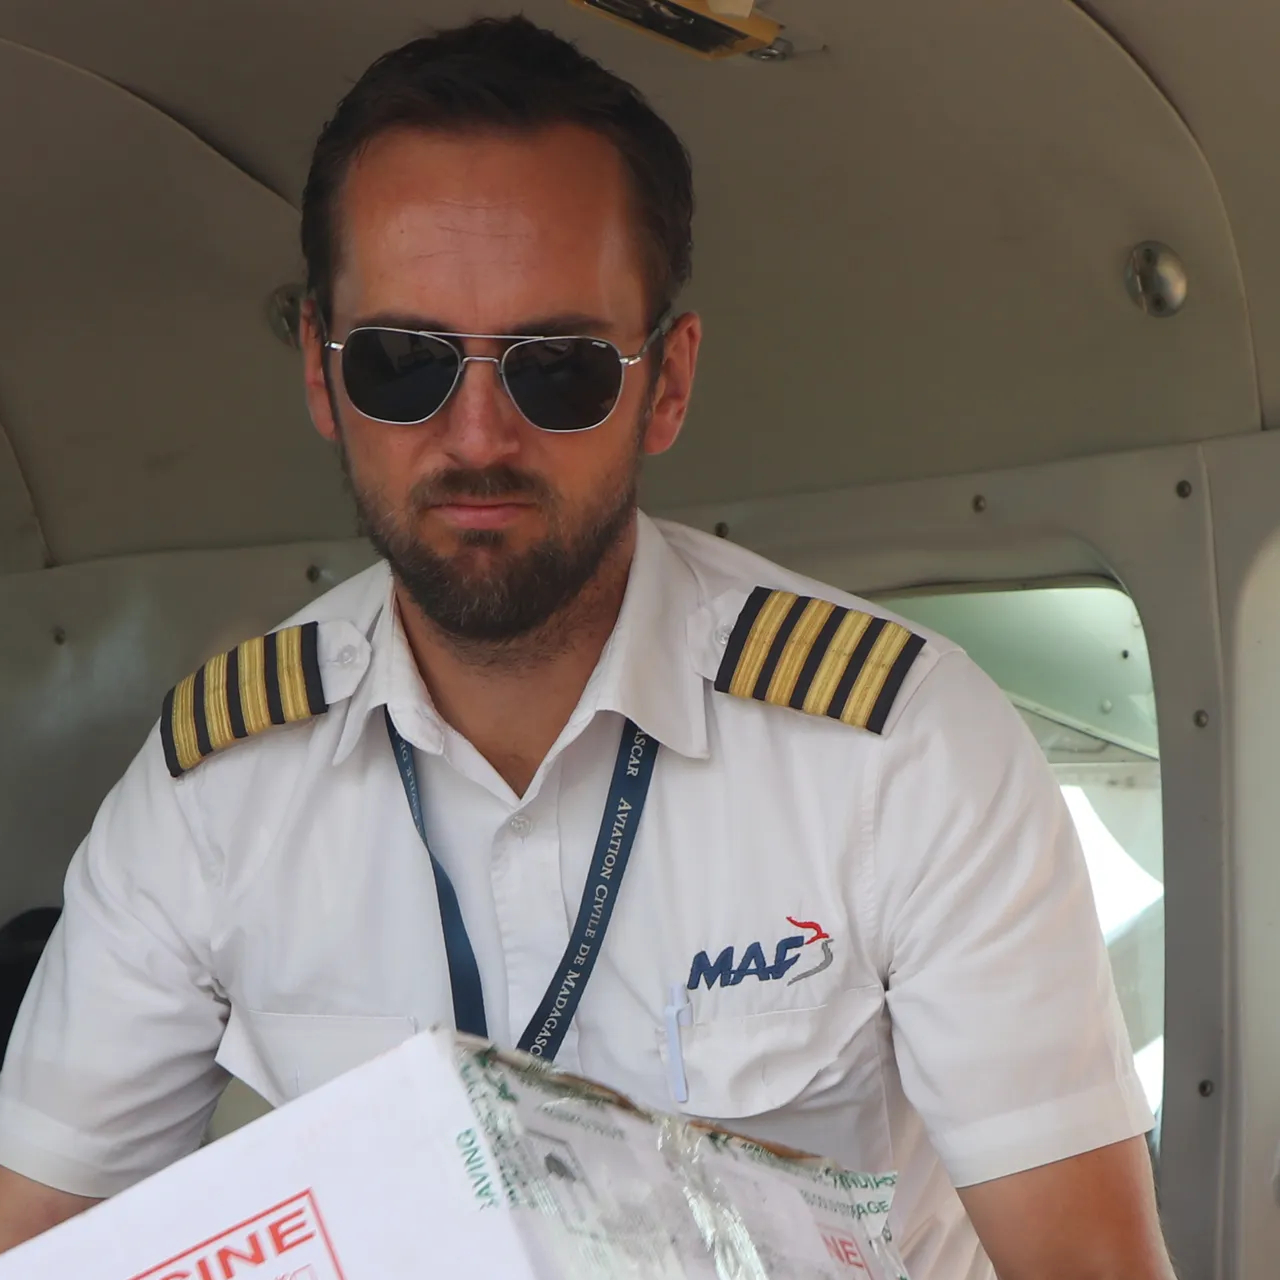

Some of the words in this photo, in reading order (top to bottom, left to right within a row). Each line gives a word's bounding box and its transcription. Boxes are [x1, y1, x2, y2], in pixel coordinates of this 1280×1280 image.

[600, 796, 632, 880] AVIATION
[585, 884, 608, 939] CIVILE
[573, 944, 591, 966] DE
[686, 935, 804, 991] MAF
